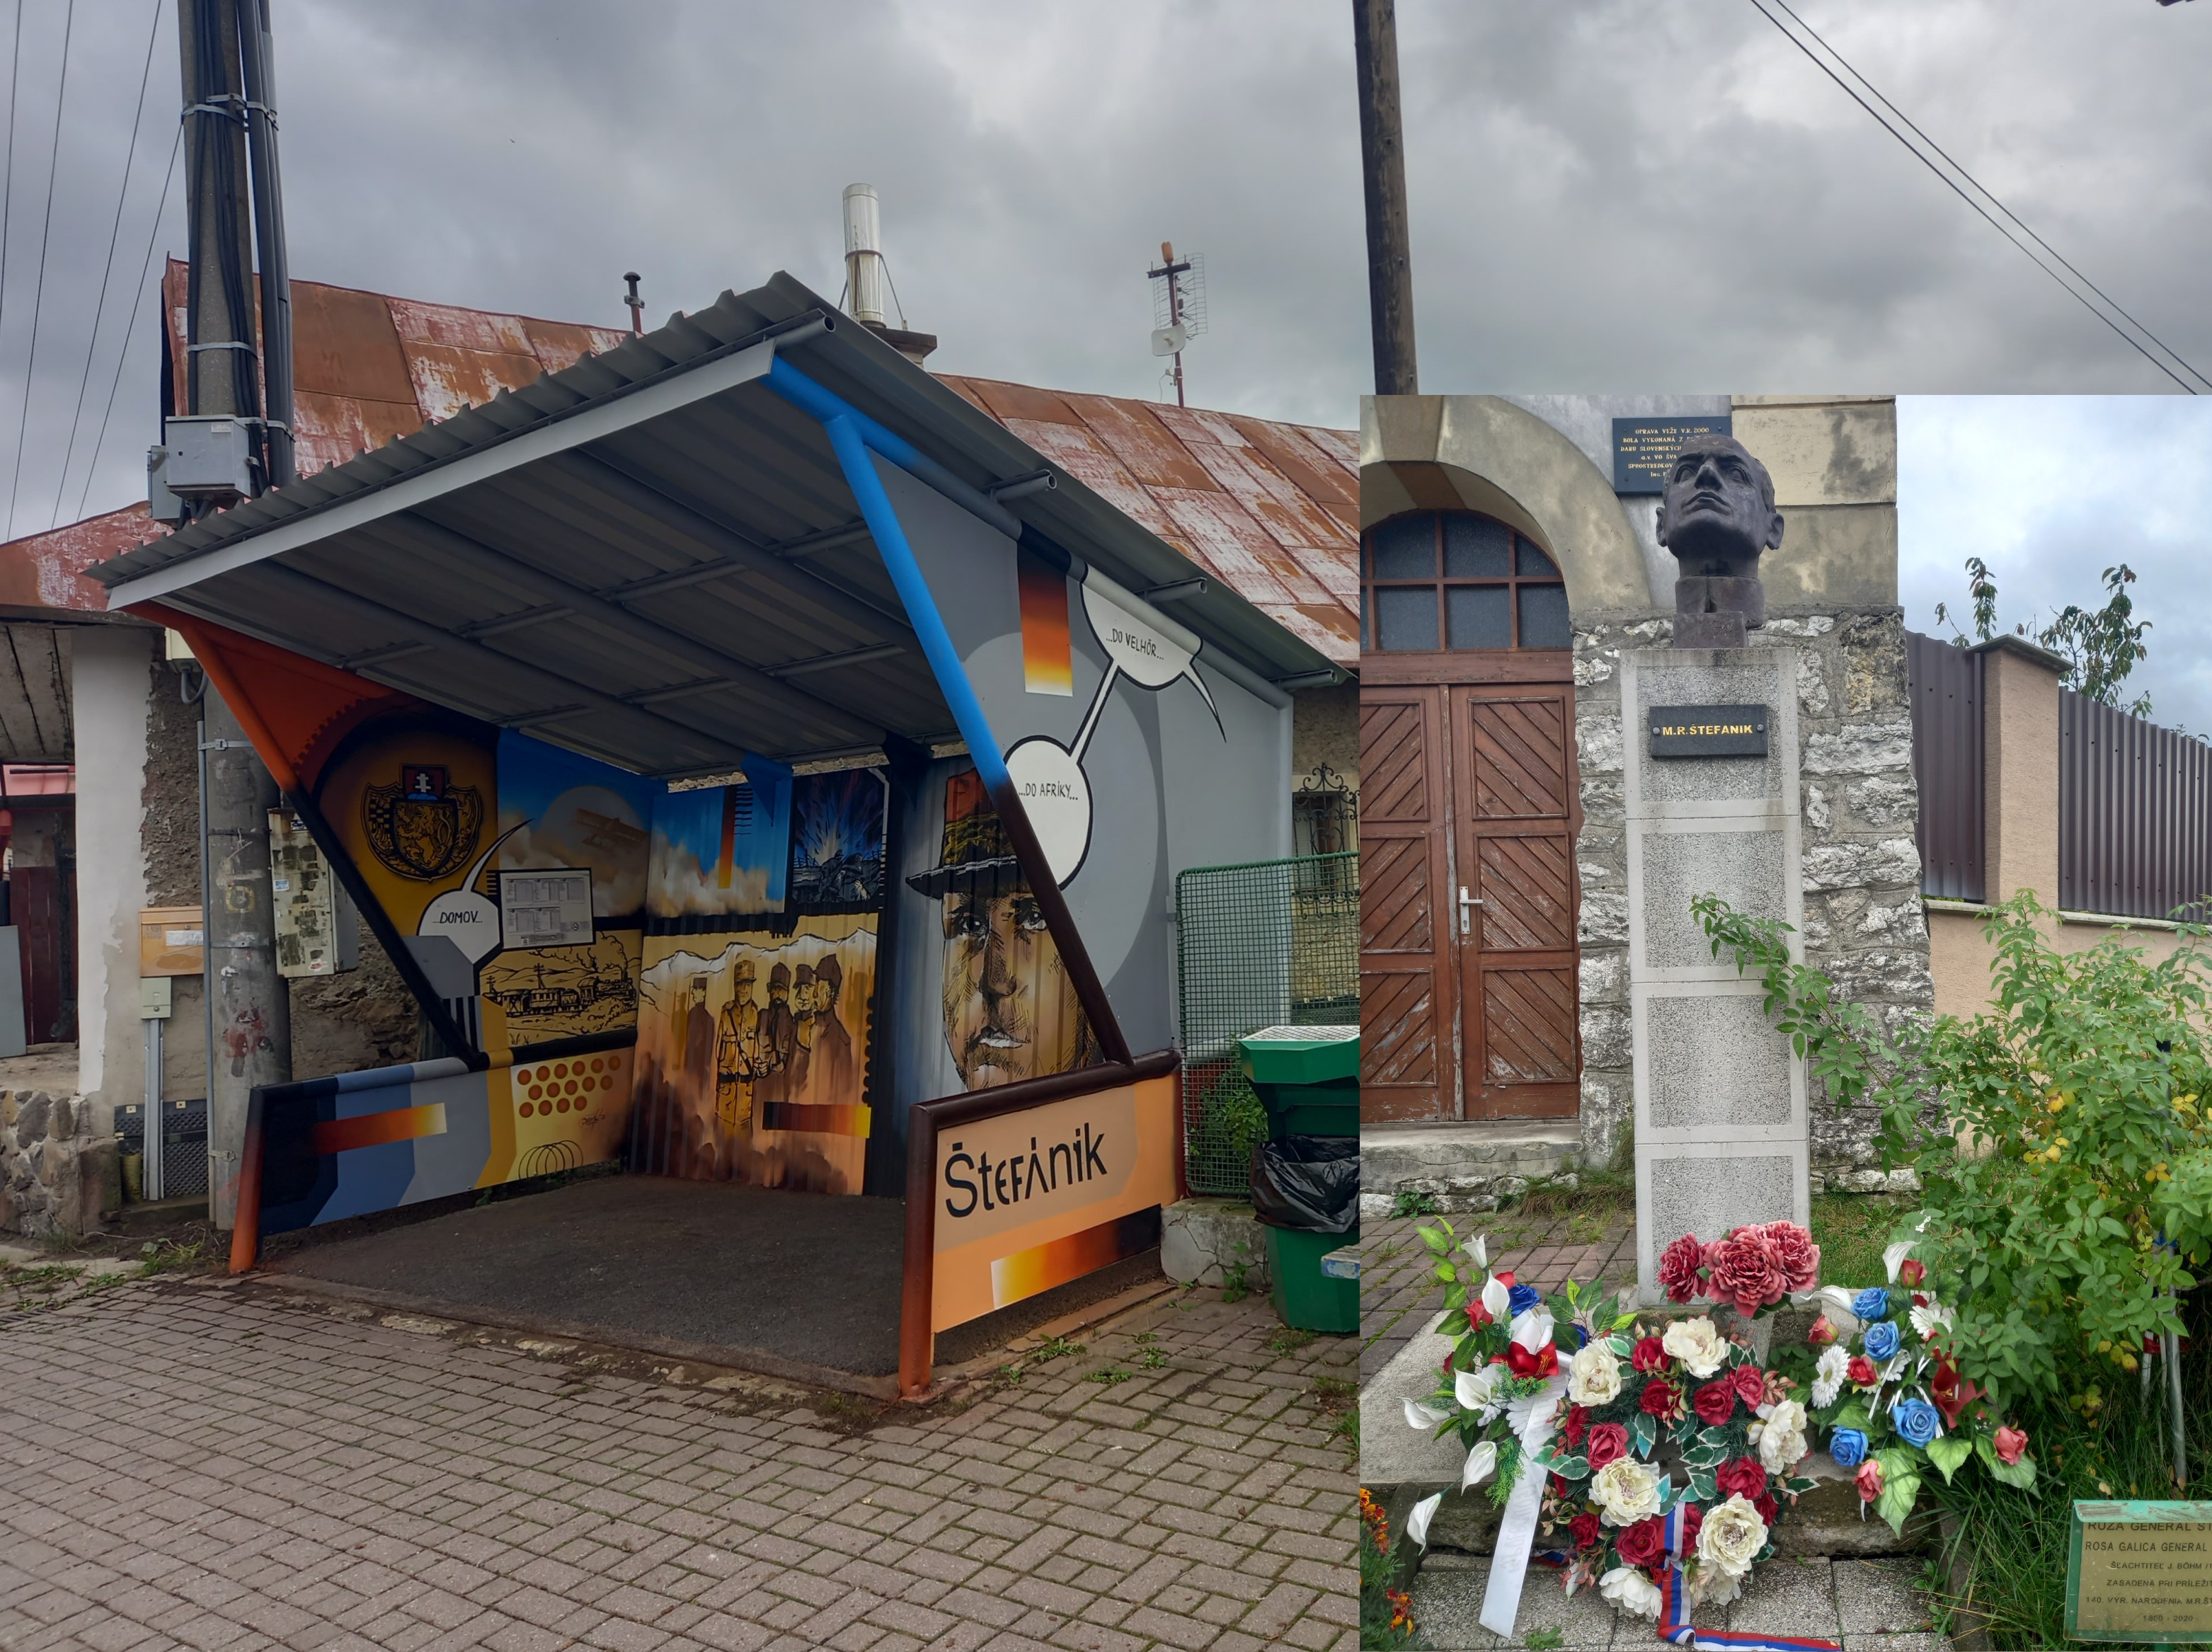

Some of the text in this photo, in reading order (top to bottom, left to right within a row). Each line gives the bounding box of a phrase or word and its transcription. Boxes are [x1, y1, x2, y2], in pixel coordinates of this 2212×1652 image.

[2131, 1522, 2191, 1531] GENERAL
[2085, 1542, 2207, 1551] ROSA GALICA GENERAL
[2107, 1578, 2155, 1587] ZASADENÁ
[2107, 1595, 2128, 1604] VÝR.
